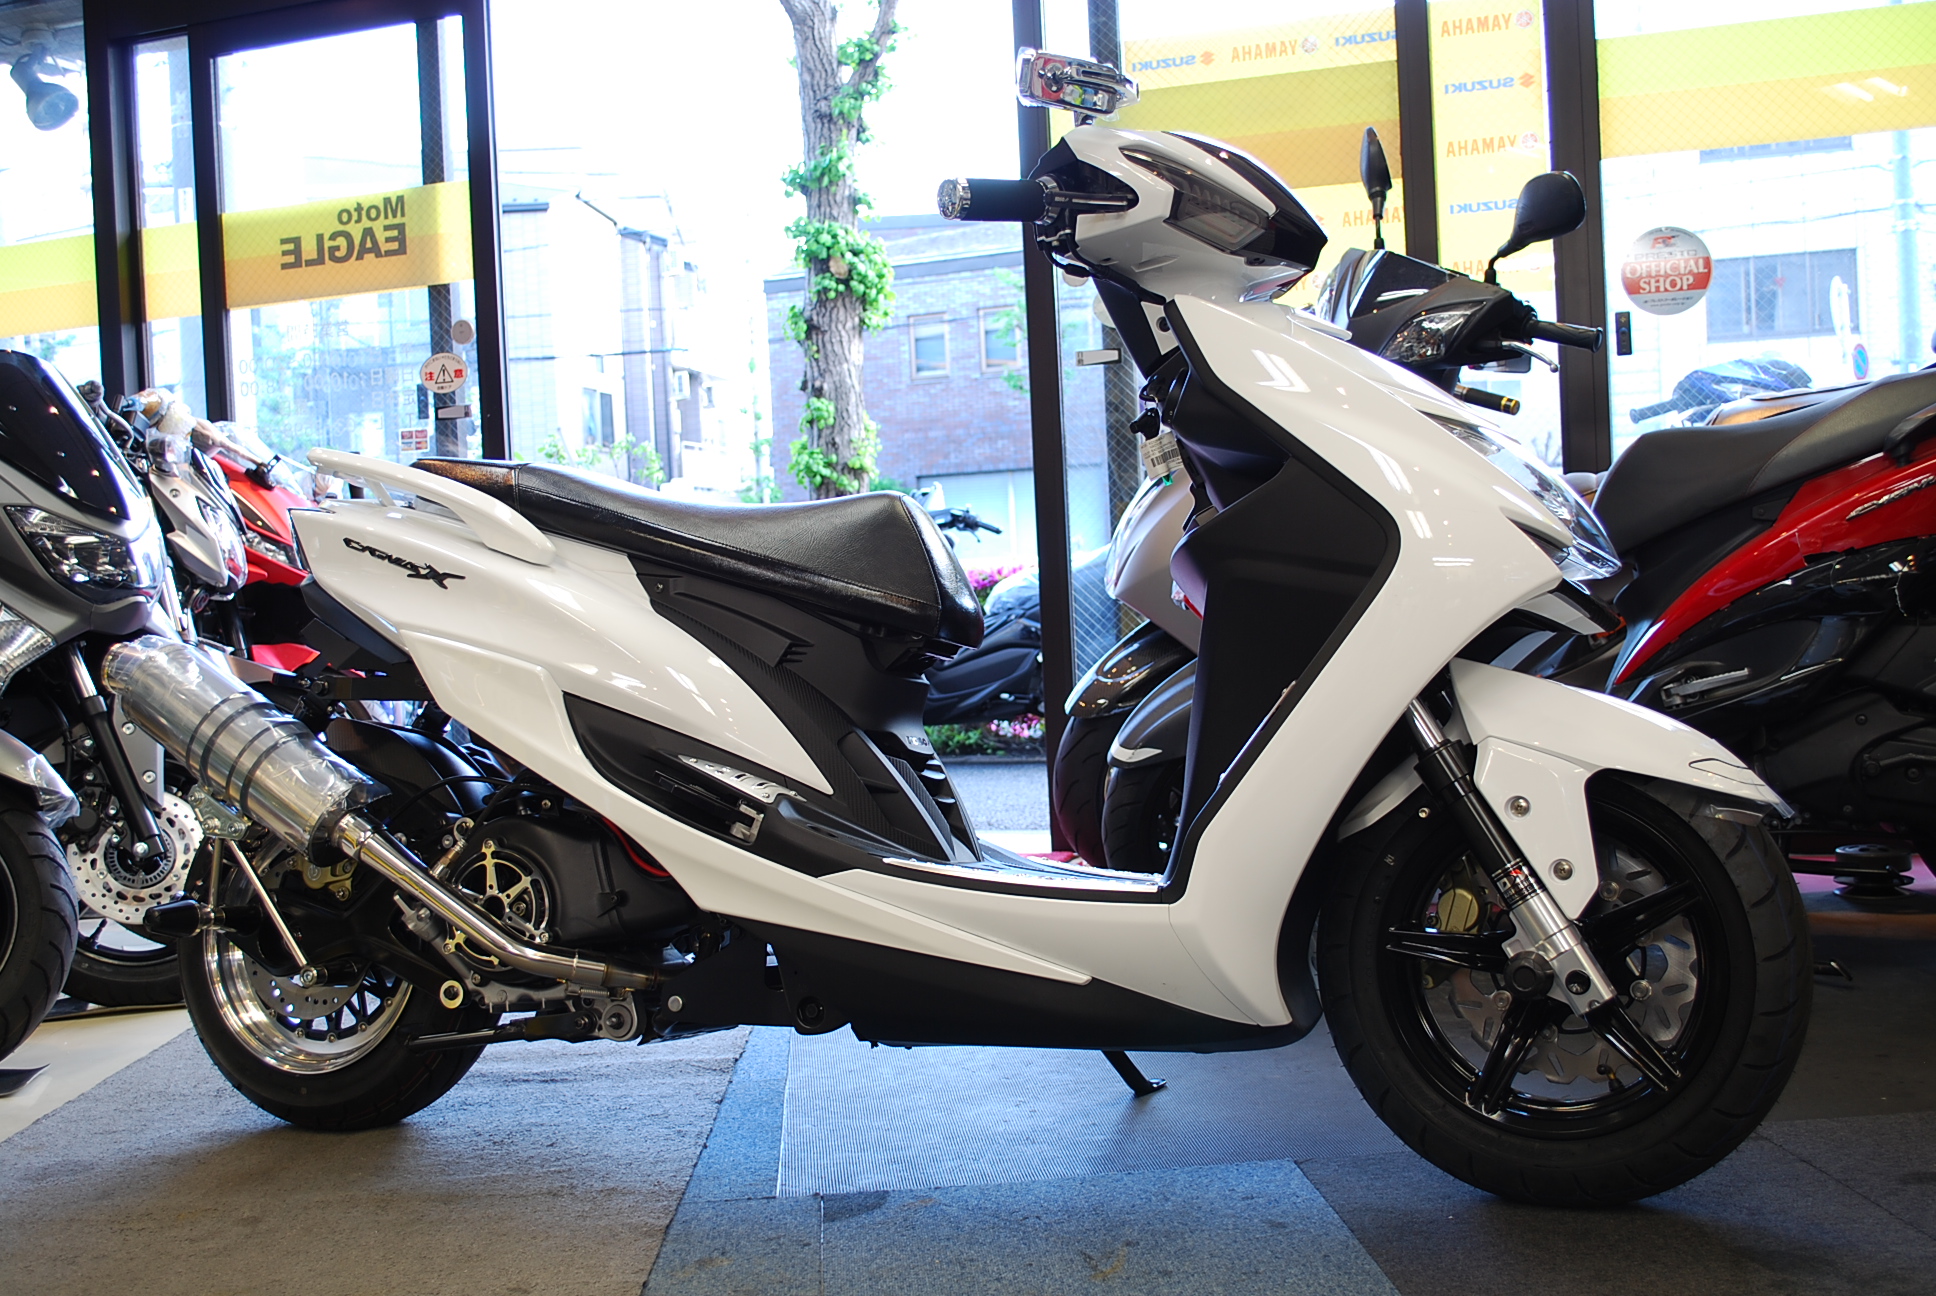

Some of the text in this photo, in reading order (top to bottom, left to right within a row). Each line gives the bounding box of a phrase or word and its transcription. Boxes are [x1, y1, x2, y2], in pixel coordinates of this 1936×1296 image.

[1634, 249, 1698, 261] PRESTO
[1625, 258, 1709, 279] OFFICIAL
[1639, 274, 1694, 294] SHOP
